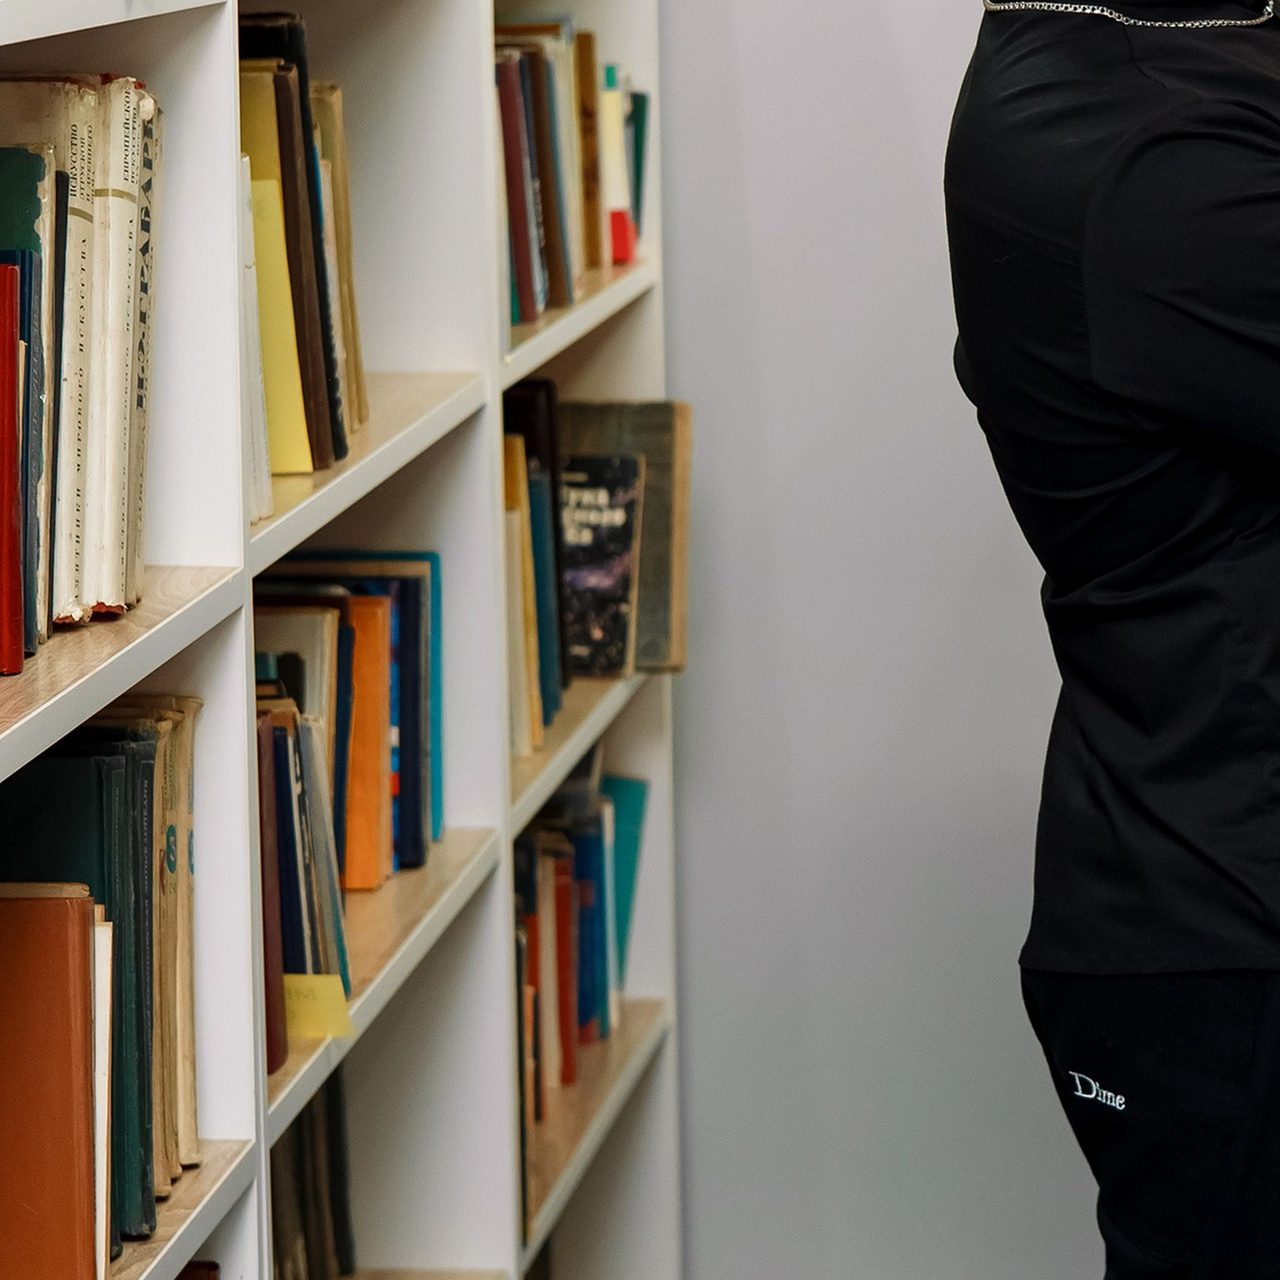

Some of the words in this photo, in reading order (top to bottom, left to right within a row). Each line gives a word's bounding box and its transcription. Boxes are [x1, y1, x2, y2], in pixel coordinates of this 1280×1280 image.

[69, 123, 79, 199] ИСКУССТВО
[121, 87, 132, 183] ЕВРОПЕЙСКОЕ
[78, 237, 88, 354] ИСКУССТВА
[75, 366, 85, 473] МИРОВОГО
[74, 487, 82, 602] АМЯТНИКИ
[1068, 1070, 1127, 1111] Dime
